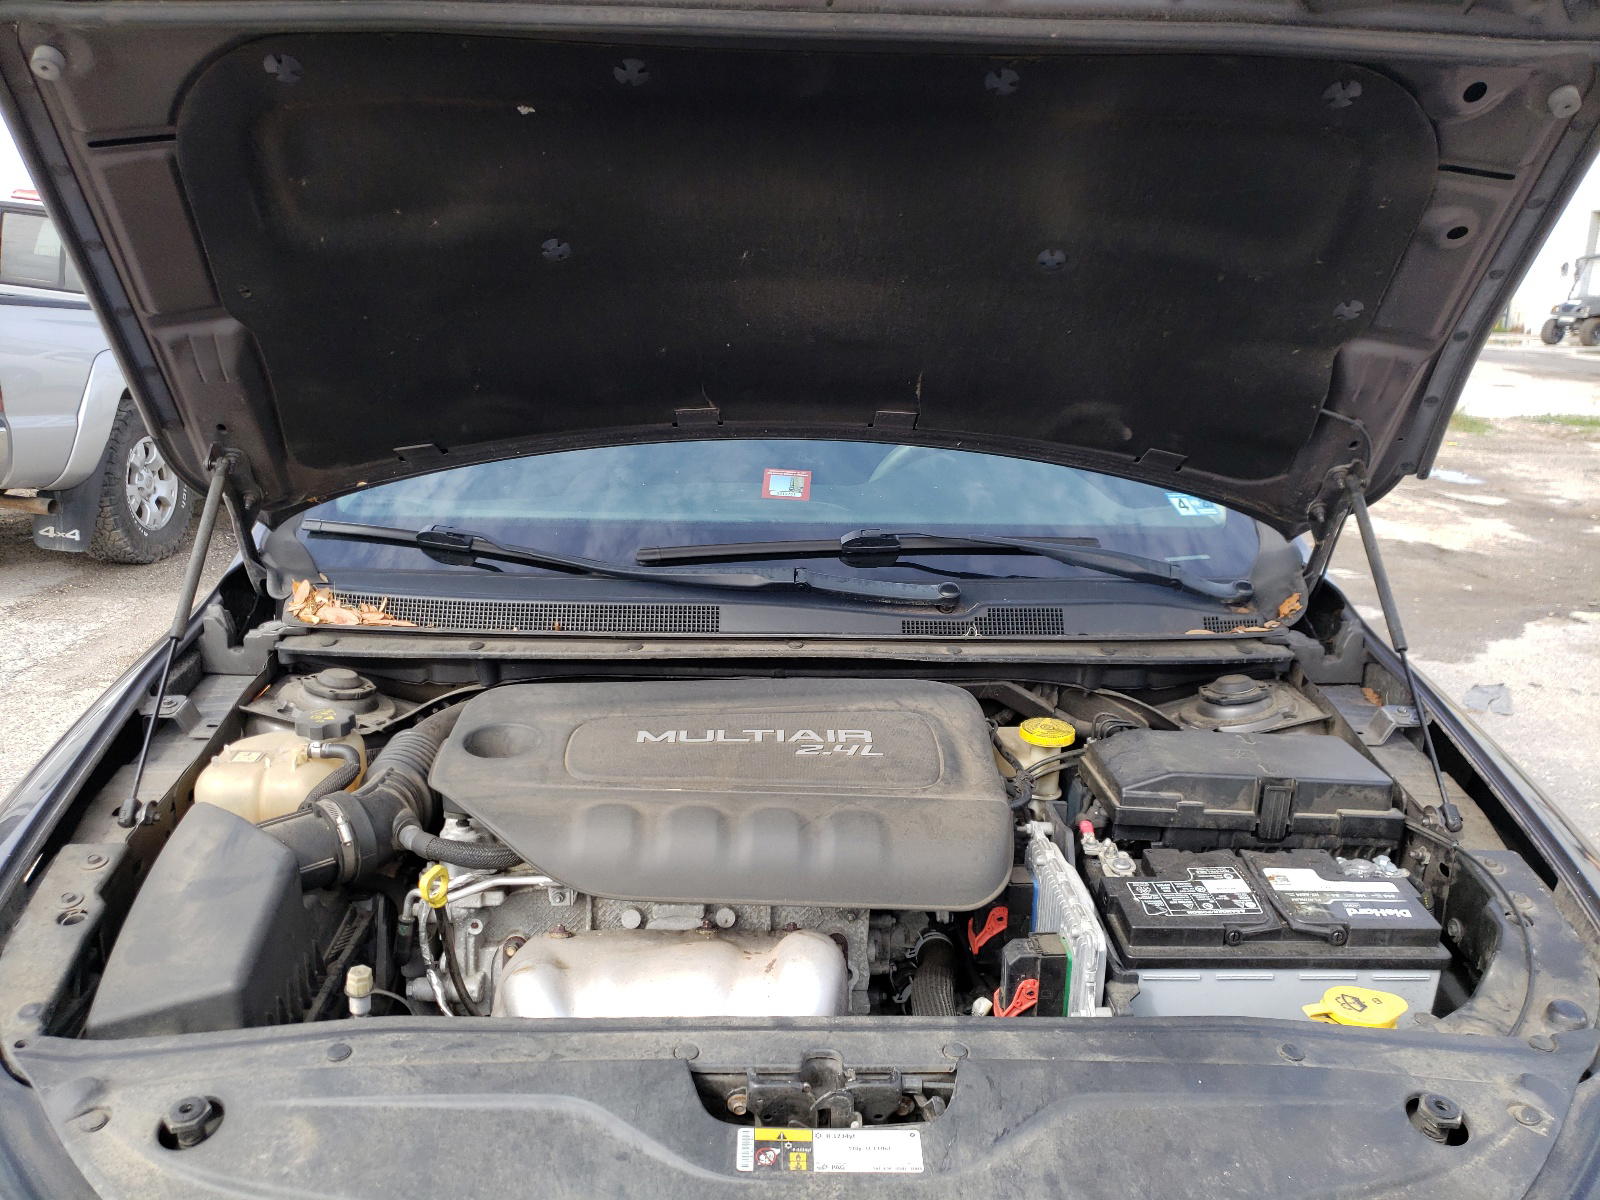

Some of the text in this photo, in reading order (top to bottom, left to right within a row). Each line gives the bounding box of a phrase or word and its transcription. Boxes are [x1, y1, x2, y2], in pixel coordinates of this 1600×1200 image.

[38, 525, 80, 541] 4x4
[636, 729, 873, 743] MULTIAIR
[795, 744, 884, 757] 2.4L
[1345, 907, 1413, 918] DieHard
